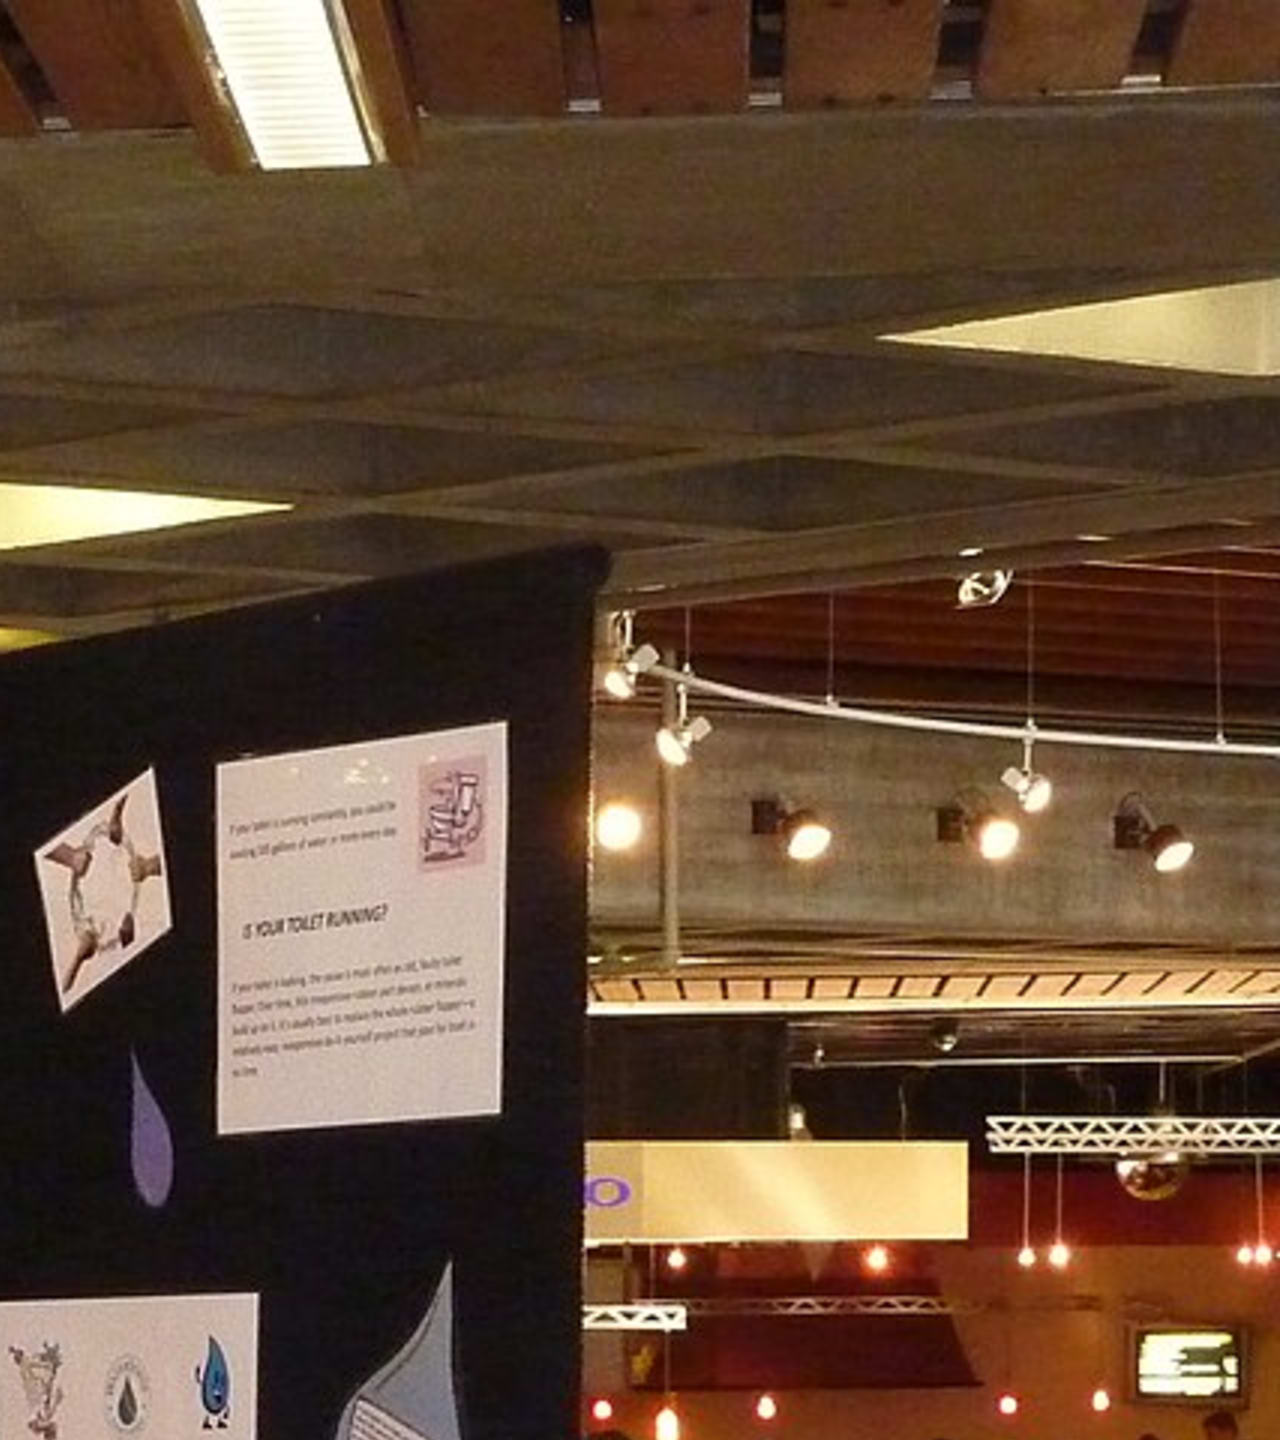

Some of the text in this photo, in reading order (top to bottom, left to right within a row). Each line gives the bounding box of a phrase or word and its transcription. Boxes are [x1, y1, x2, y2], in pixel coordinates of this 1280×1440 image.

[256, 917, 284, 938] YOUR
[288, 913, 324, 934] TOILET
[326, 903, 390, 928] RUNNING?
